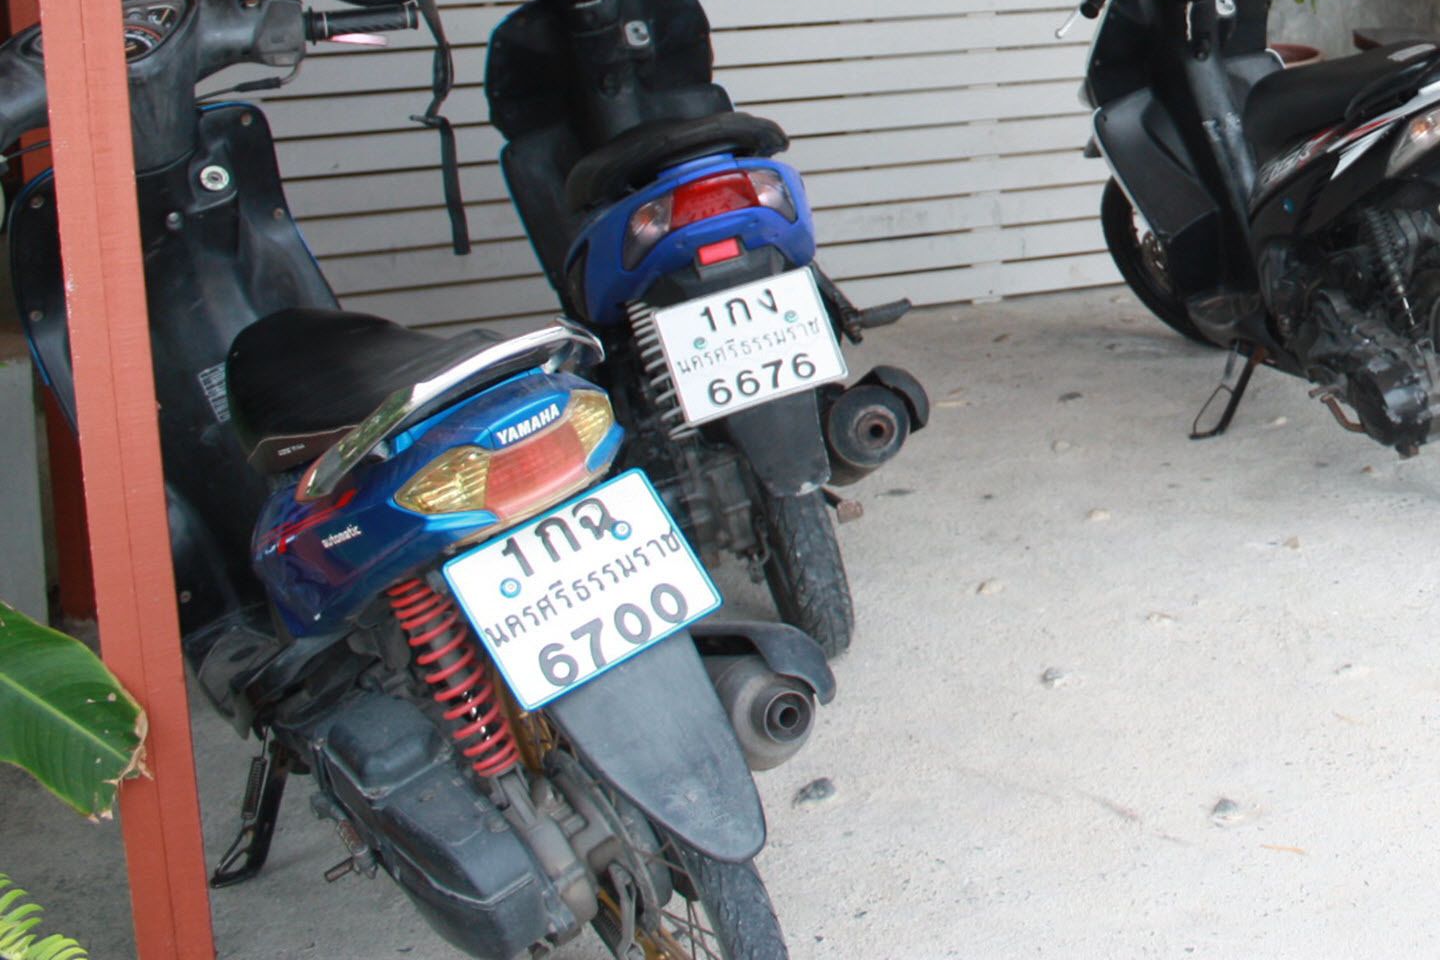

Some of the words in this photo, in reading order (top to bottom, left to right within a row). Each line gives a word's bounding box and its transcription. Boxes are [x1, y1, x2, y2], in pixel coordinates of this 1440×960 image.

[677, 317, 820, 374] นครศรีธรรมราช
[707, 353, 816, 406] 6676
[496, 403, 560, 445] YAMAHA
[484, 525, 681, 647] นครศรีธรรมราช
[538, 583, 688, 687] 6700
